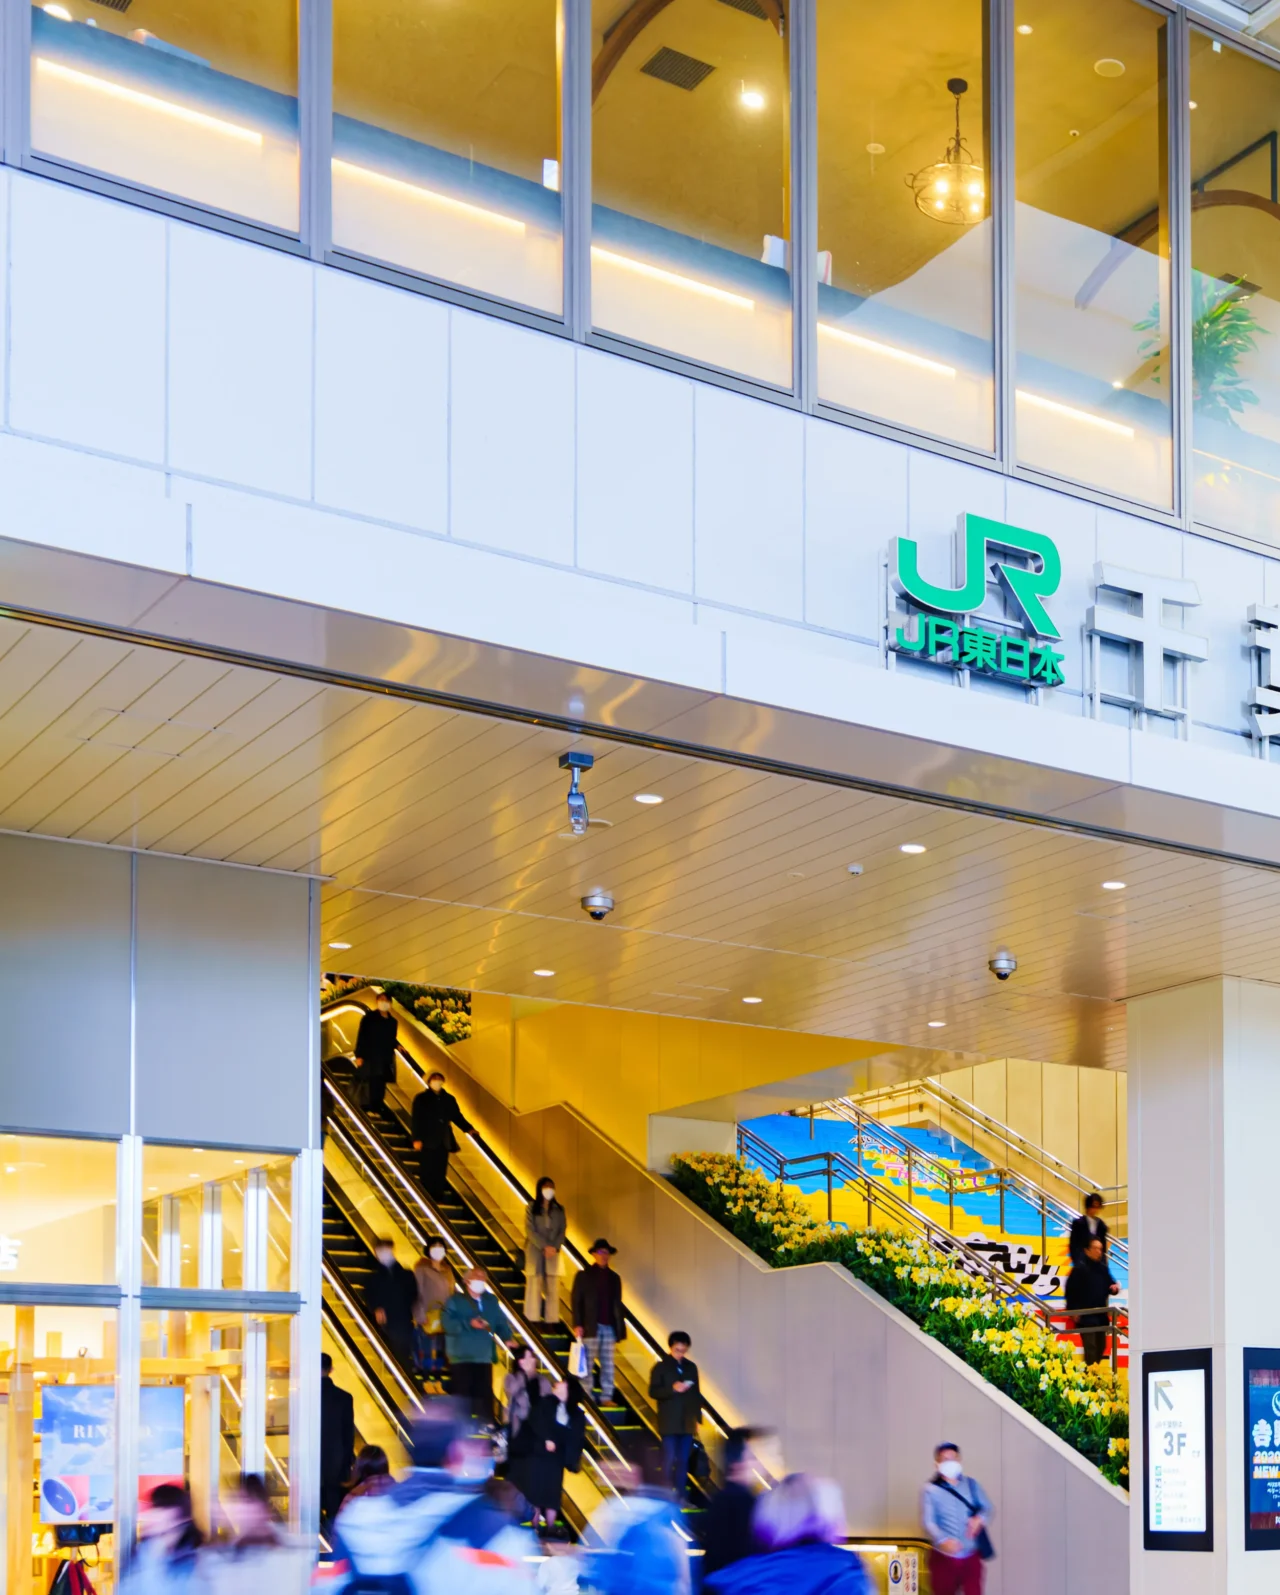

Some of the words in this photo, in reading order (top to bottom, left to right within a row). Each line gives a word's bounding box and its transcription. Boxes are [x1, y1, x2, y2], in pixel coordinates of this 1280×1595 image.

[896, 511, 1062, 643] JR
[895, 613, 1066, 686] JR東日本
[1163, 1431, 1187, 1456] 3F
[1254, 1465, 1279, 1478] NEW
